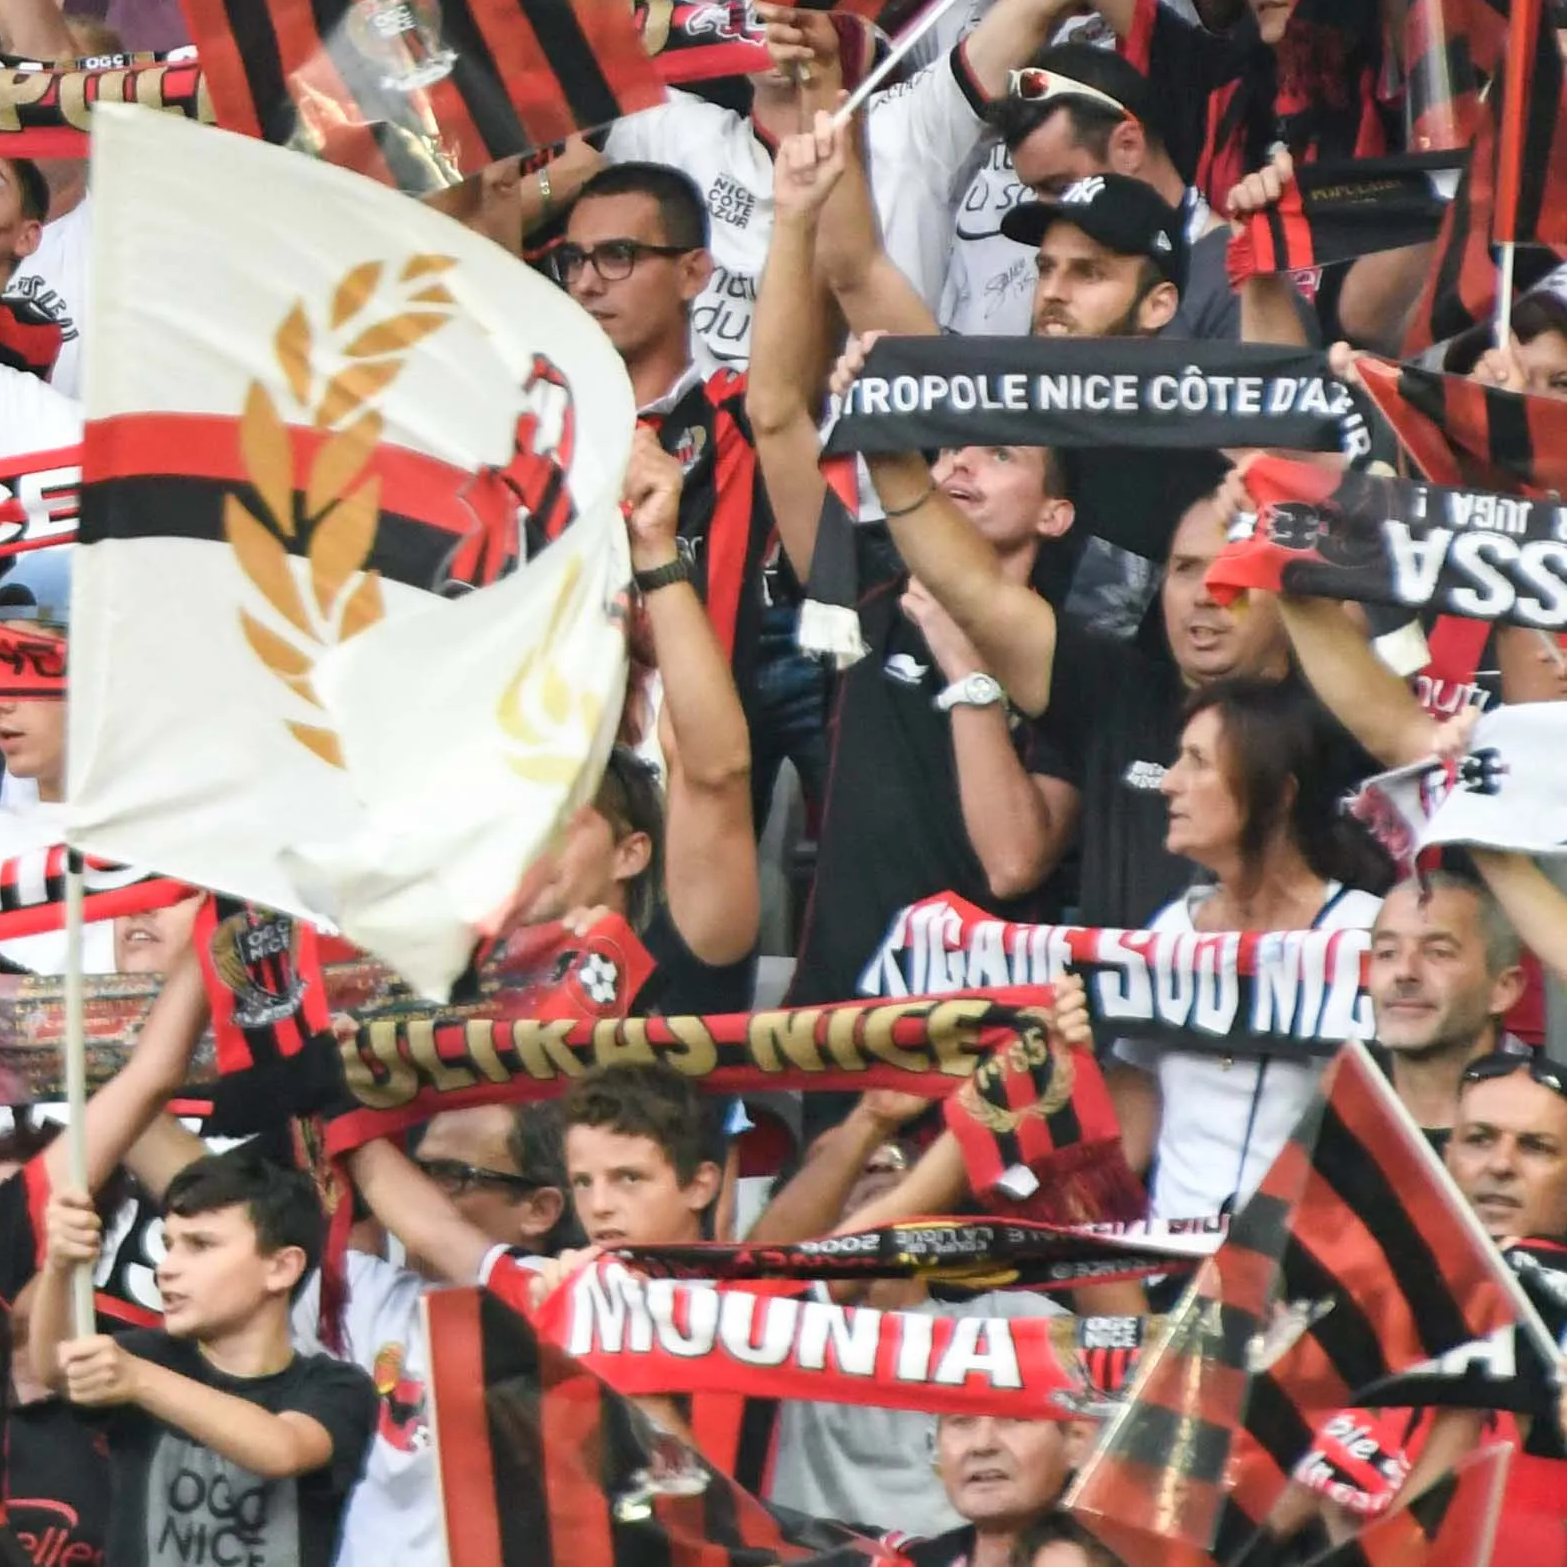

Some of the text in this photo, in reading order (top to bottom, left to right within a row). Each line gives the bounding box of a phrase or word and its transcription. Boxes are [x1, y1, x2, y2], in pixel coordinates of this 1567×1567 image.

[691, 298, 751, 344] du
[1040, 374, 1139, 411] NICE
[1150, 365, 1261, 413] CÔTE
[749, 1000, 993, 1077] NICE
[568, 1262, 1024, 1391] MOUNTA
